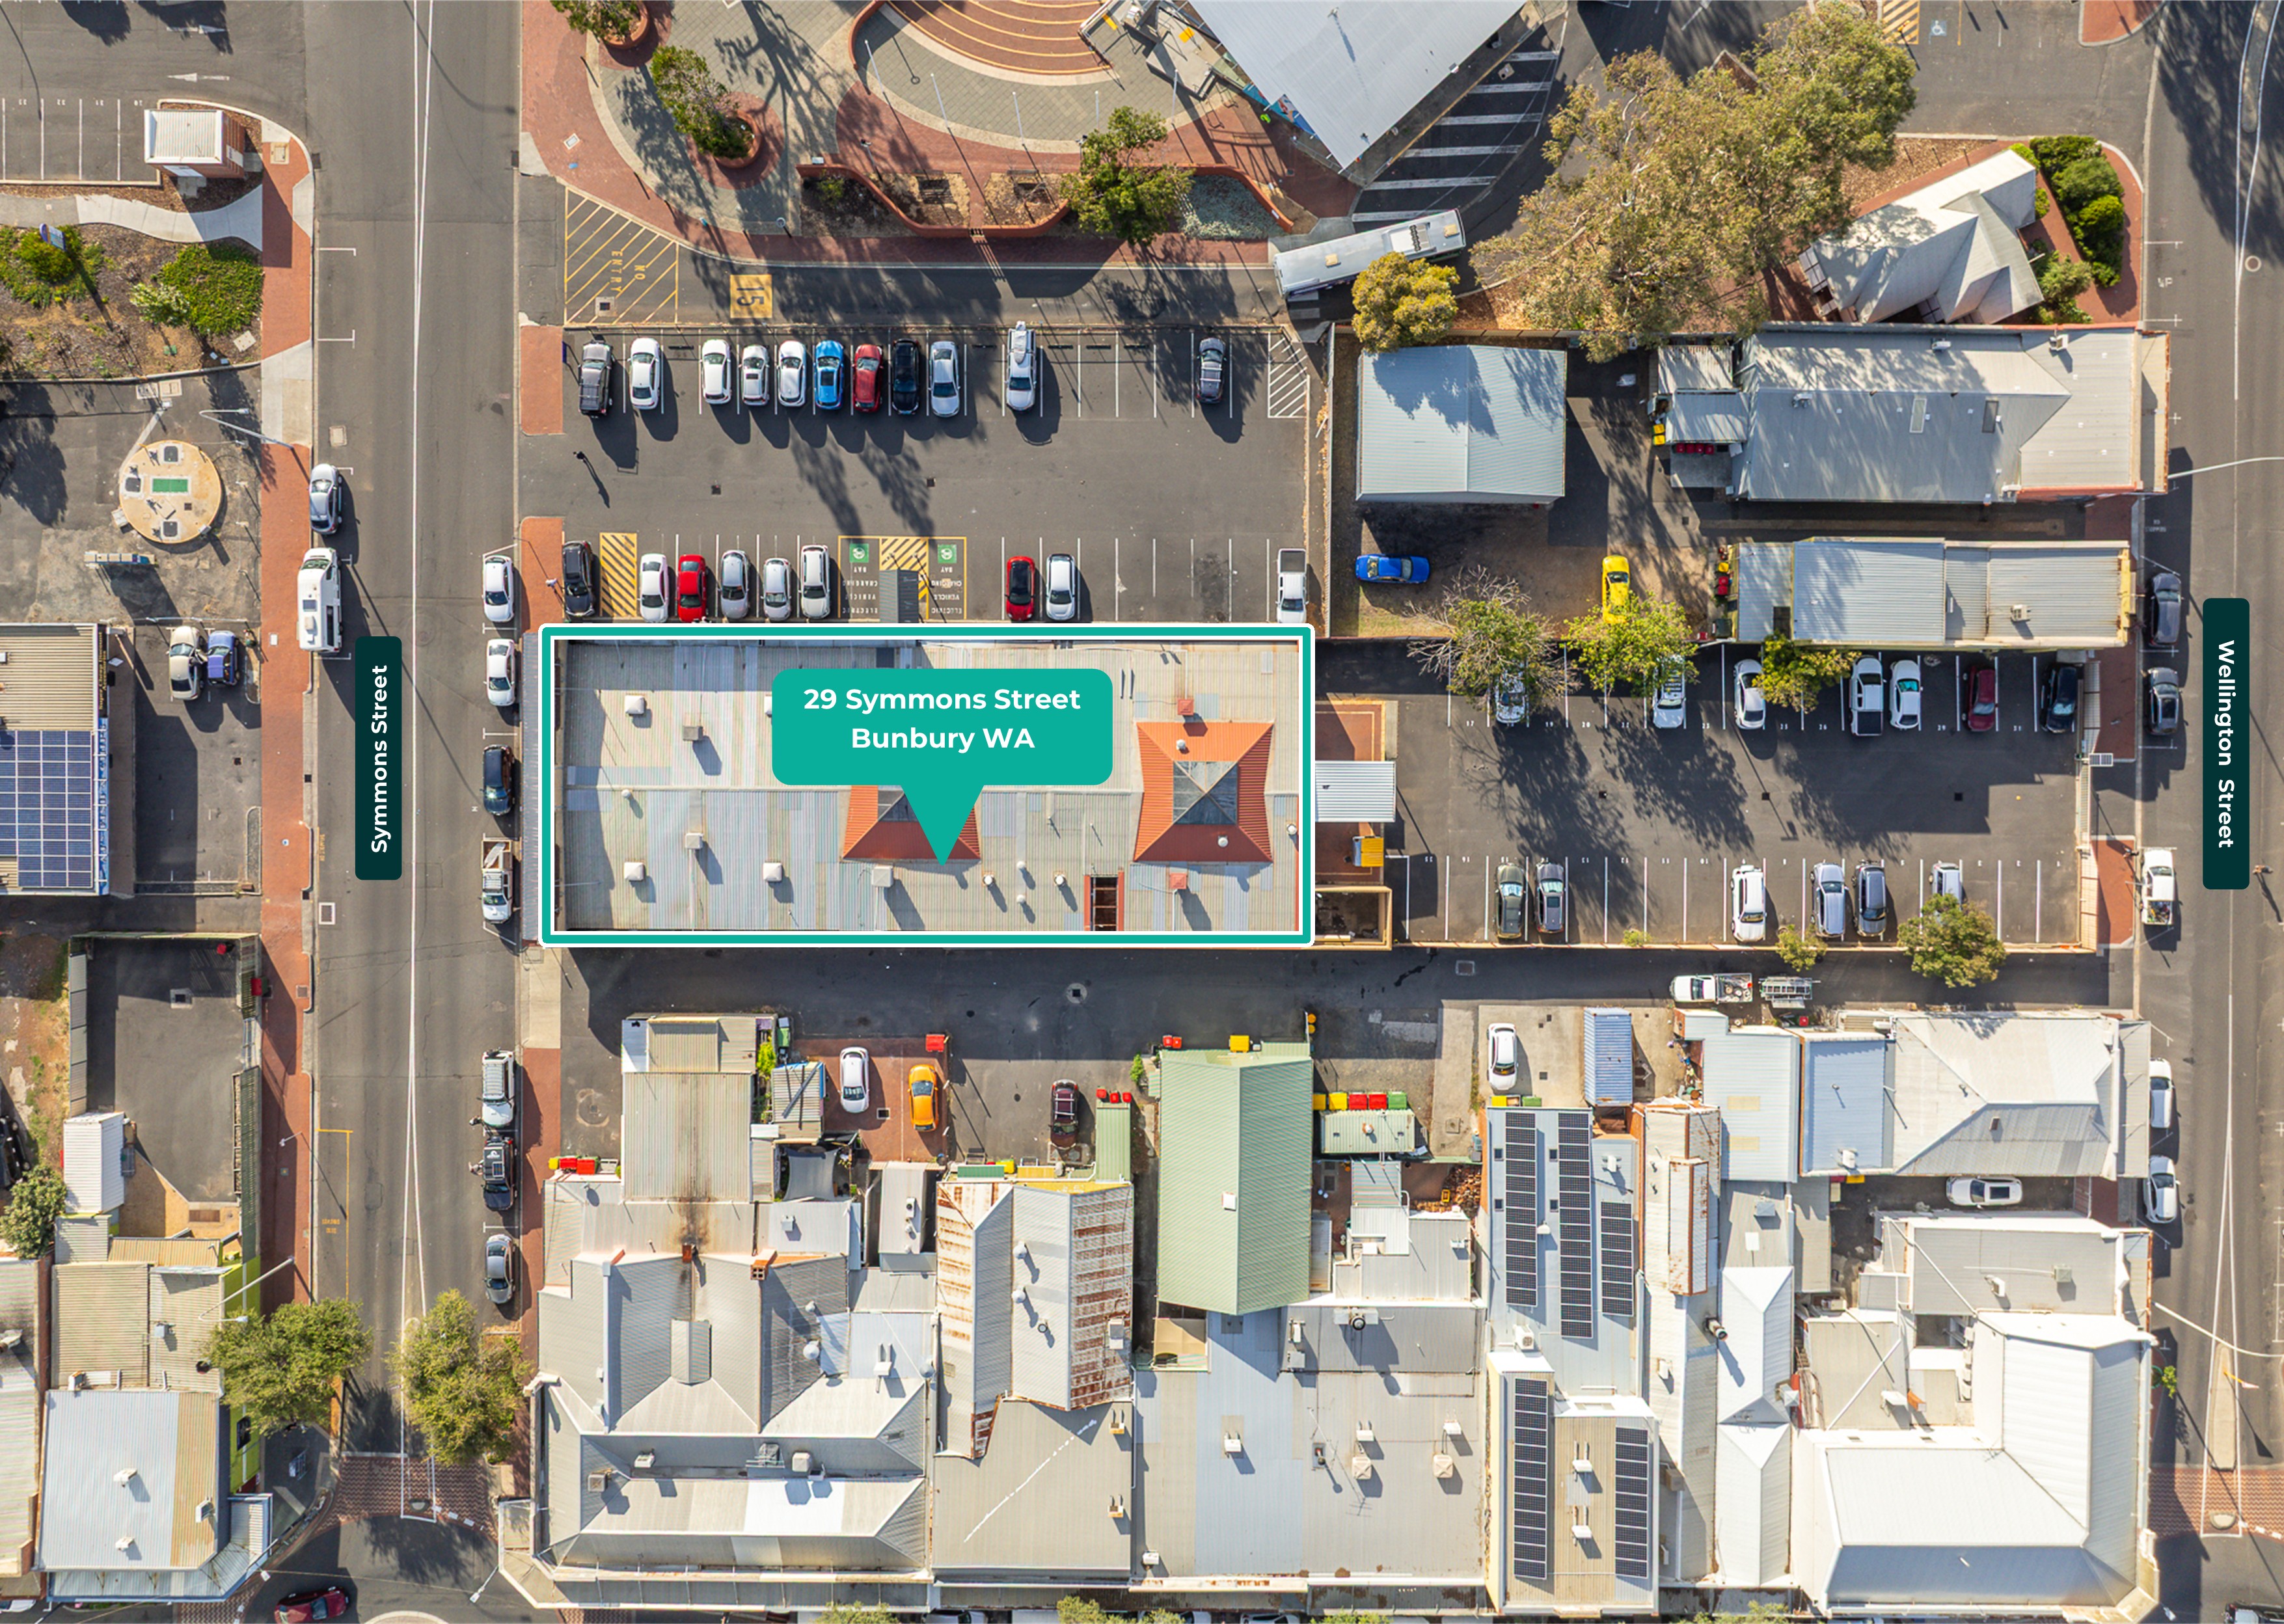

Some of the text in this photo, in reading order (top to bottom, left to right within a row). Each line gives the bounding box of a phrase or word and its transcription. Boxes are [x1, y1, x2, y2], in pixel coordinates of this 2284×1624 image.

[611, 250, 623, 292] ENTRY
[634, 265, 646, 280] NO
[737, 286, 765, 306] 15
